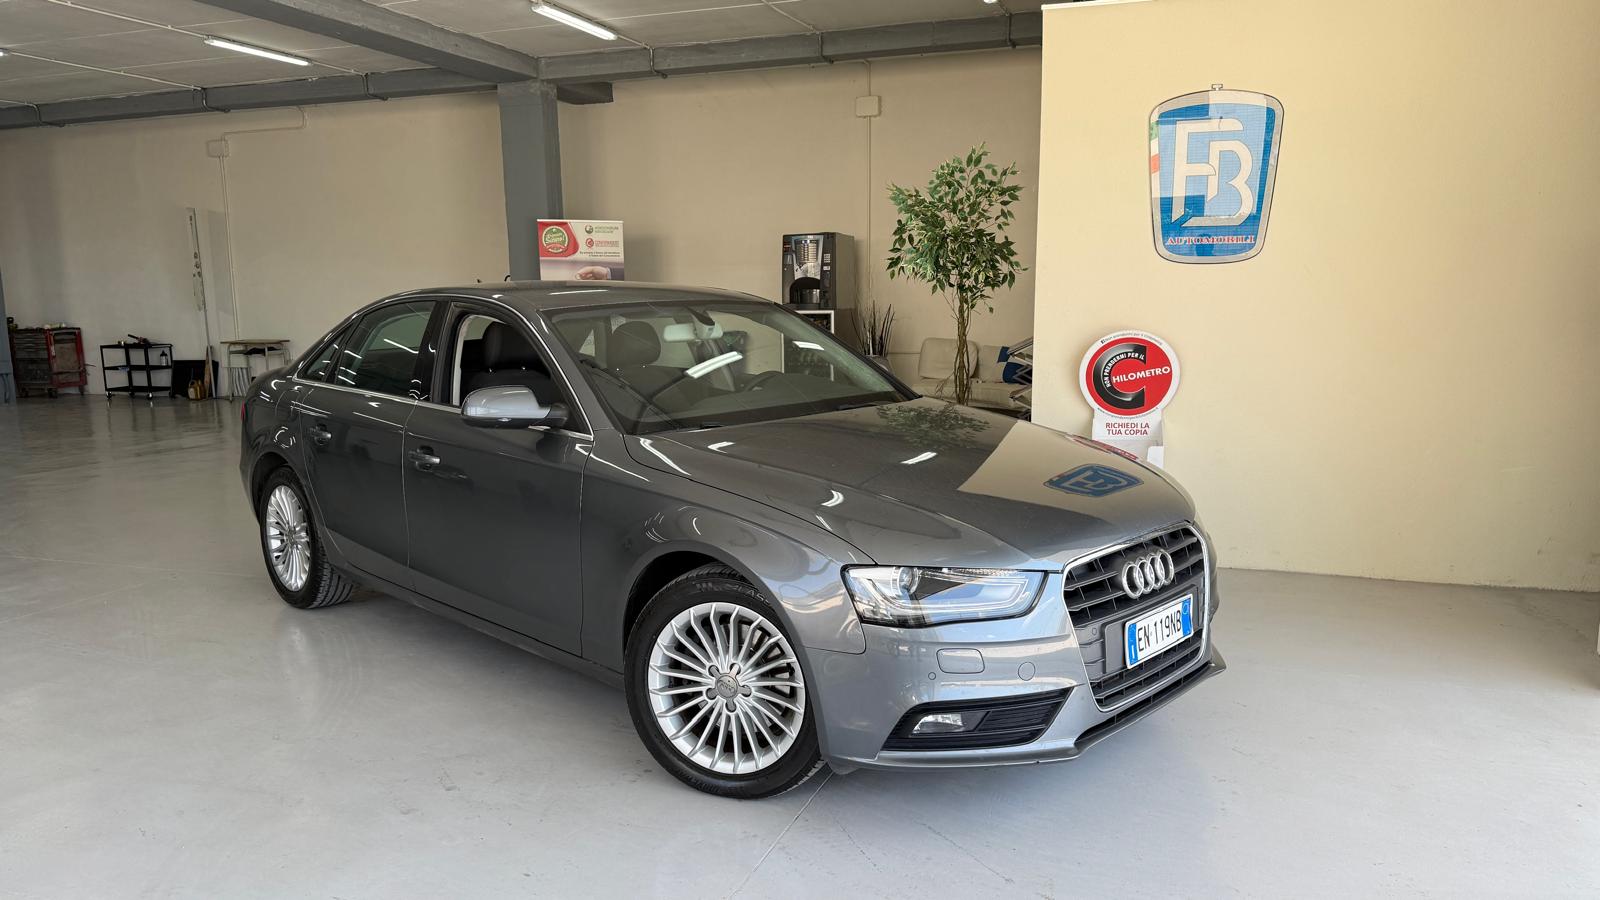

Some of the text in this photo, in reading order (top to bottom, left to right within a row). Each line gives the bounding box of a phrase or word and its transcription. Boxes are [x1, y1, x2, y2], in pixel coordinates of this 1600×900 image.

[1167, 234, 1256, 245] AUTOMOBILI
[1103, 377, 1111, 388] NON
[1107, 428, 1149, 436] TUA COPIA
